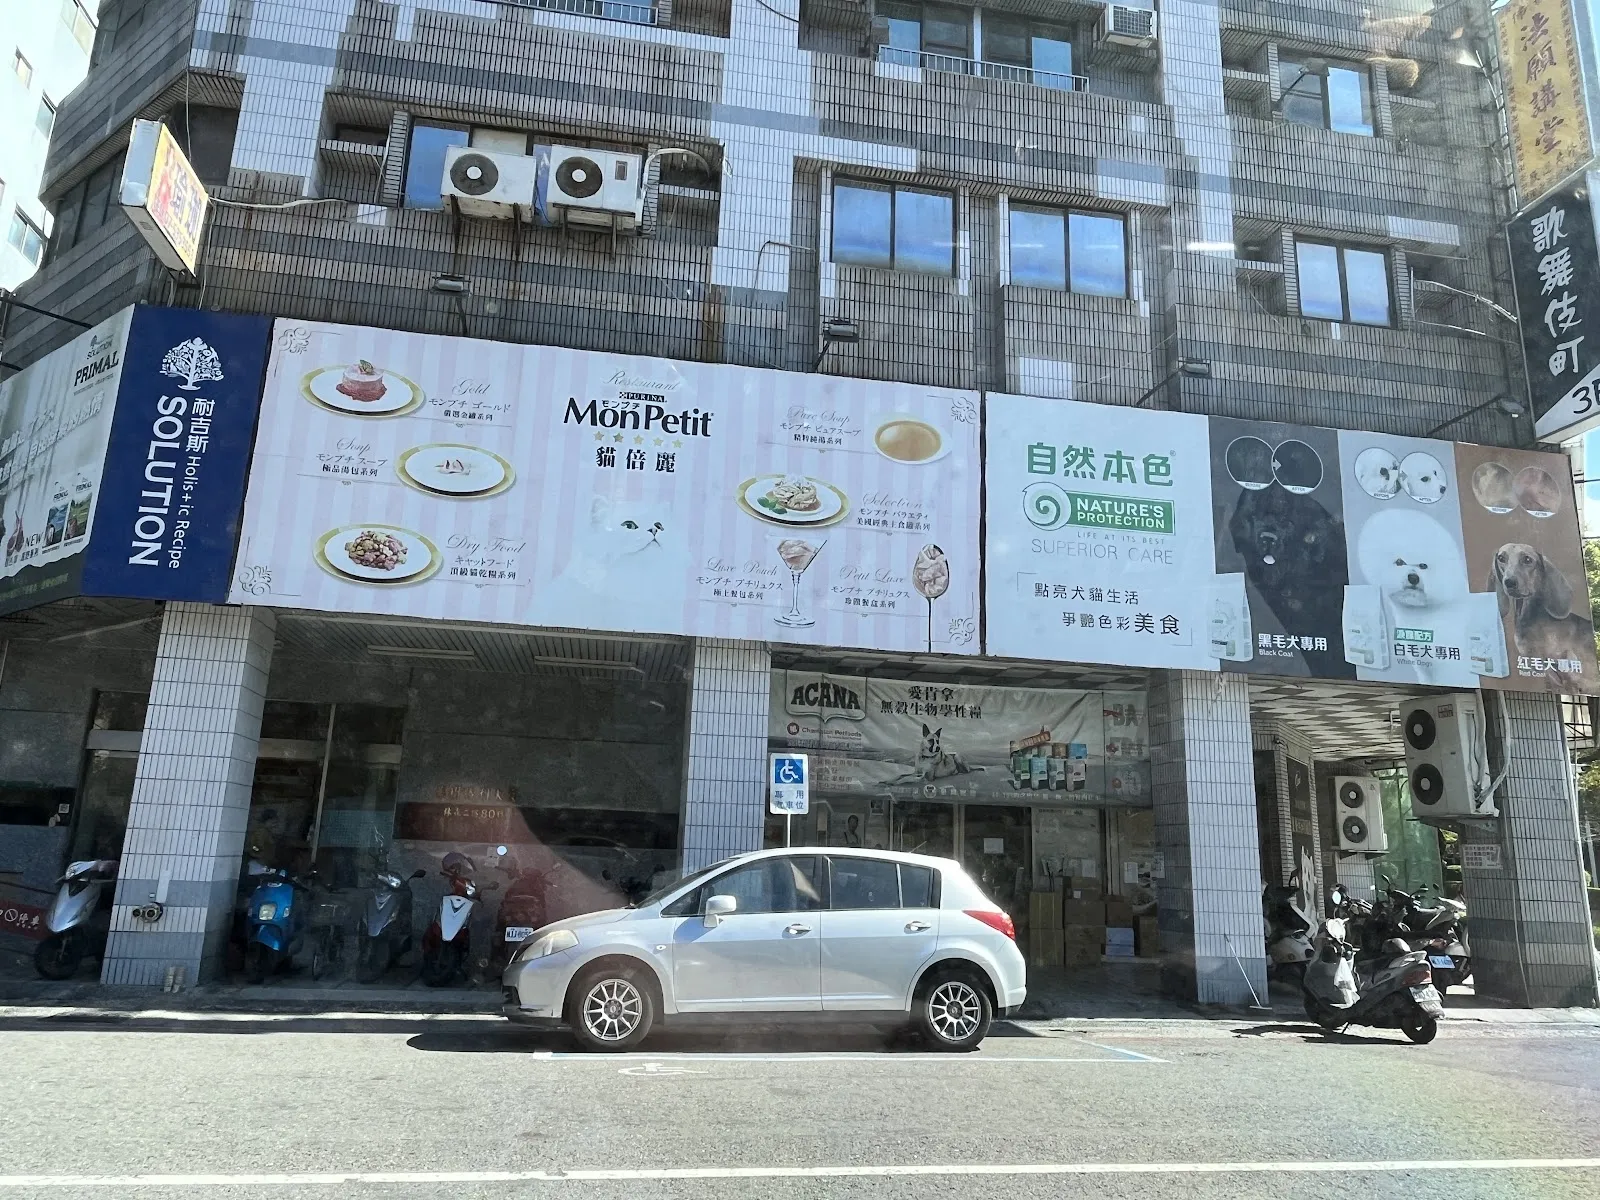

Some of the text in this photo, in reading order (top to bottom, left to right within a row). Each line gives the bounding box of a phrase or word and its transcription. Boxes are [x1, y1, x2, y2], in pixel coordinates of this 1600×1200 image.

[1531, 205, 1585, 377] 歌舞伎町
[74, 350, 120, 387] PRIMAL
[451, 377, 491, 396] Gold
[627, 392, 665, 402] PURINA
[186, 397, 215, 453] 耐吉斯
[336, 436, 371, 456] Soup
[595, 446, 676, 472] 貓倍麗
[1027, 442, 1174, 487] 自然本色
[128, 394, 188, 566] SOLUTION
[862, 492, 923, 509] Selection
[1077, 497, 1164, 518] NATURE'S
[1077, 512, 1165, 529] PROTECTION
[25, 533, 42, 547] NEW
[168, 520, 191, 569] Recipe
[446, 533, 527, 556] Dry Food
[1077, 531, 1097, 540] LIFE
[1122, 535, 1136, 543] ITS
[1142, 537, 1165, 545] BEST
[1031, 538, 1173, 565] SUPERIOR CARE
[839, 565, 870, 581] Petit
[1034, 582, 1139, 606] 點亮犬貓生活
[1258, 632, 1328, 652] 黑毛犬專用
[1394, 643, 1461, 660] 白毛犬專用
[1258, 648, 1294, 658] Black Coat
[1517, 655, 1583, 674] 紅毛犬專用
[790, 682, 861, 710] ACANA
[907, 685, 954, 702] 愛肯拿
